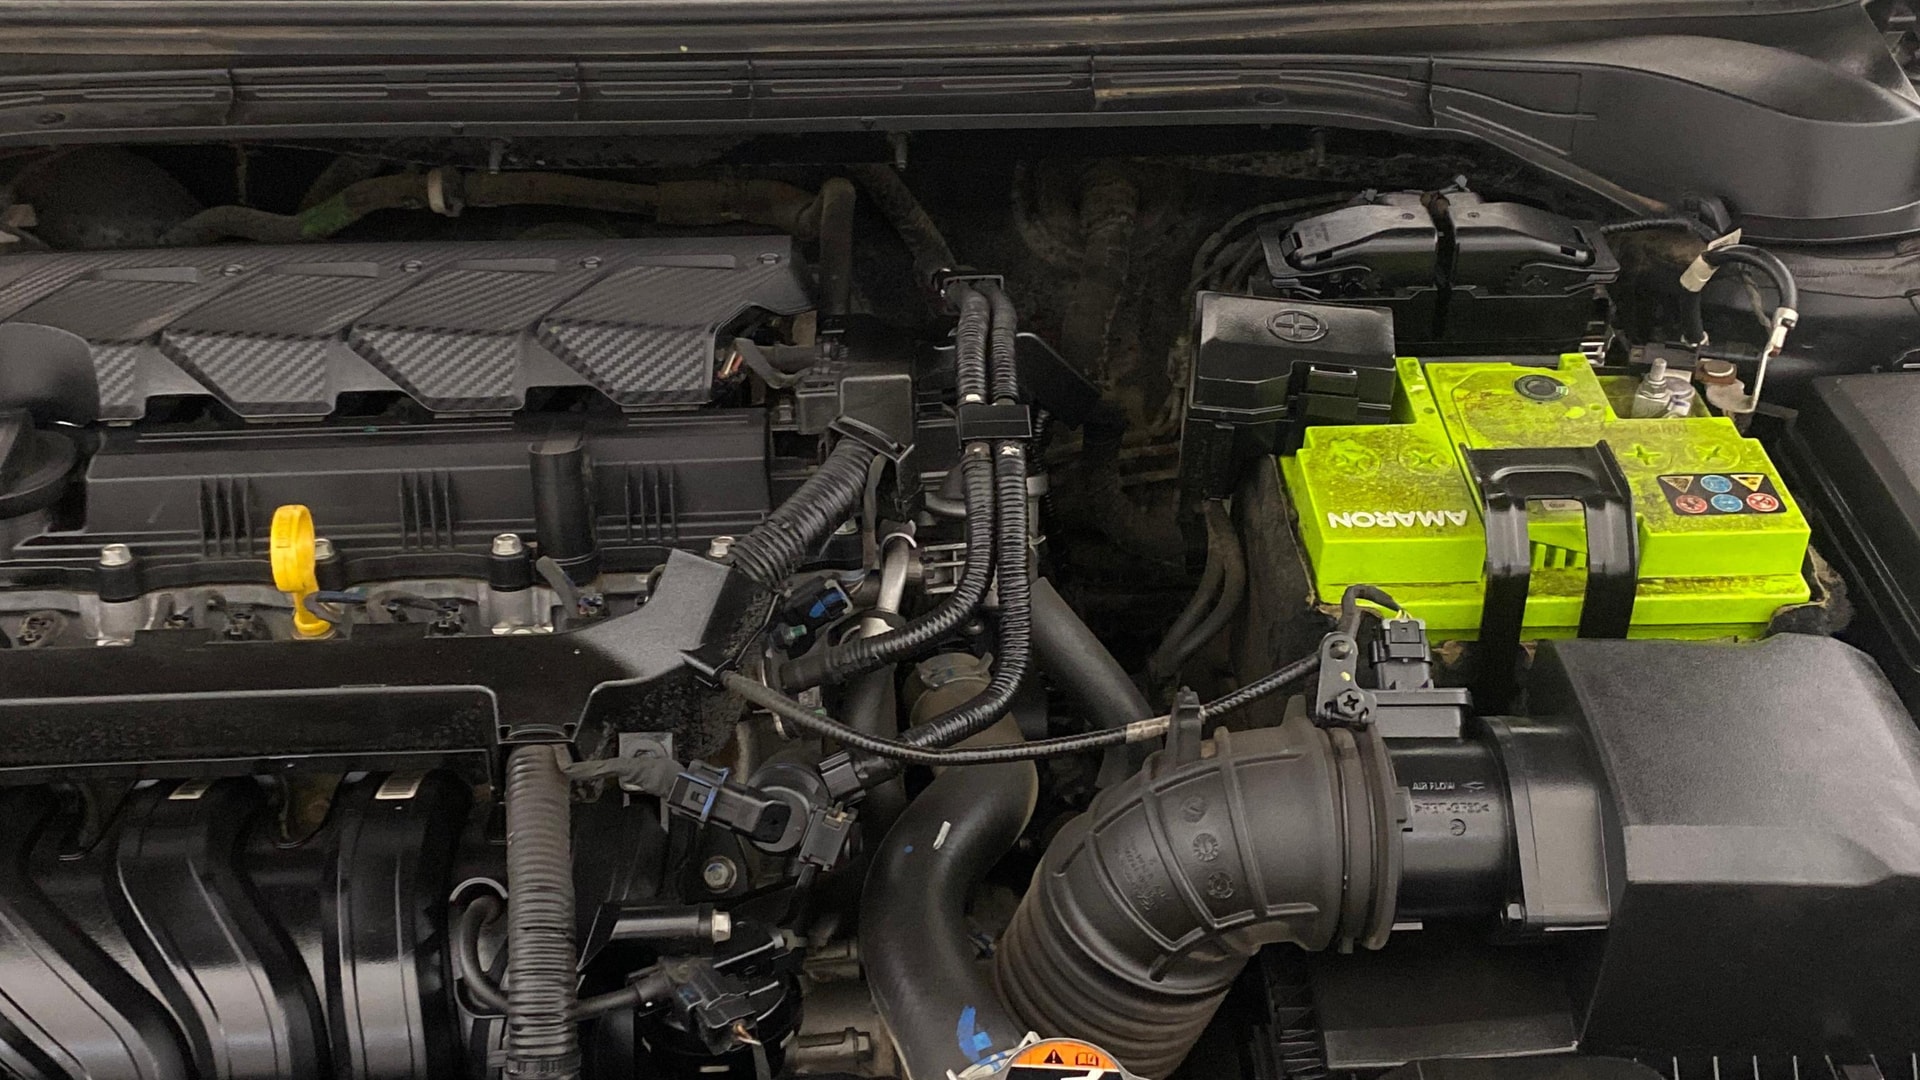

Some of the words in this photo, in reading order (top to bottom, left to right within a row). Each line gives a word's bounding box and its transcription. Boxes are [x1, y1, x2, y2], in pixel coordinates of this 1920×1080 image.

[1327, 510, 1468, 529] AMARON
[1412, 782, 1428, 790] AIR
[1430, 782, 1455, 790] FLOW
